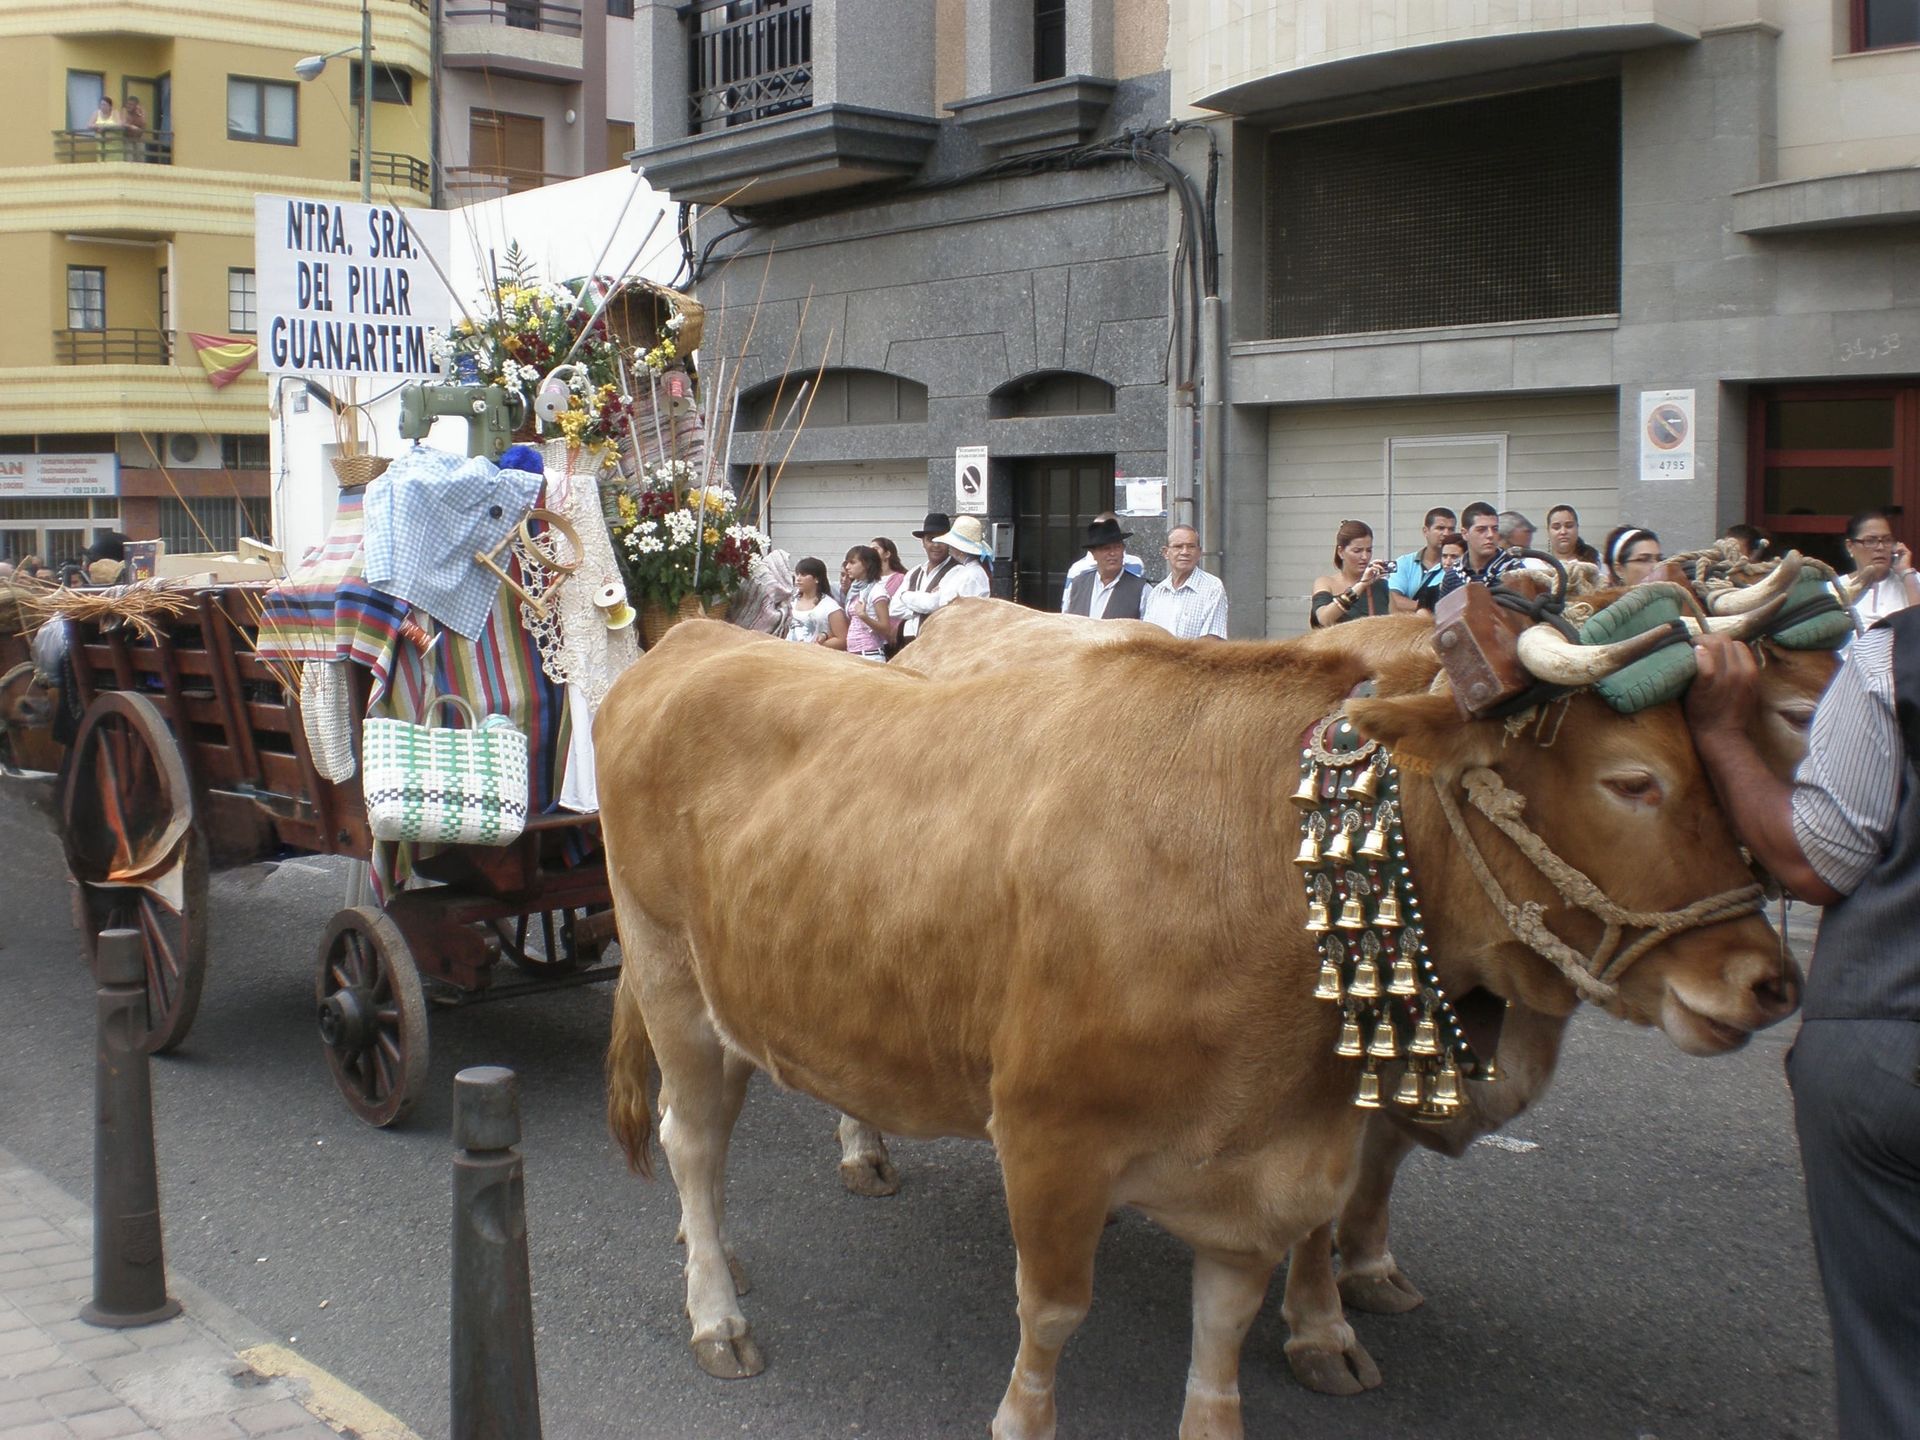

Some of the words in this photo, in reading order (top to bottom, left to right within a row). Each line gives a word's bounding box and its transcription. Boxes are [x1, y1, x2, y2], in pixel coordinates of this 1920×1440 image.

[286, 200, 353, 256] NTRA.
[368, 208, 418, 260] SRA.
[297, 260, 333, 312] DEL
[348, 265, 412, 316] PILAR
[1659, 460, 1685, 470] 4795
